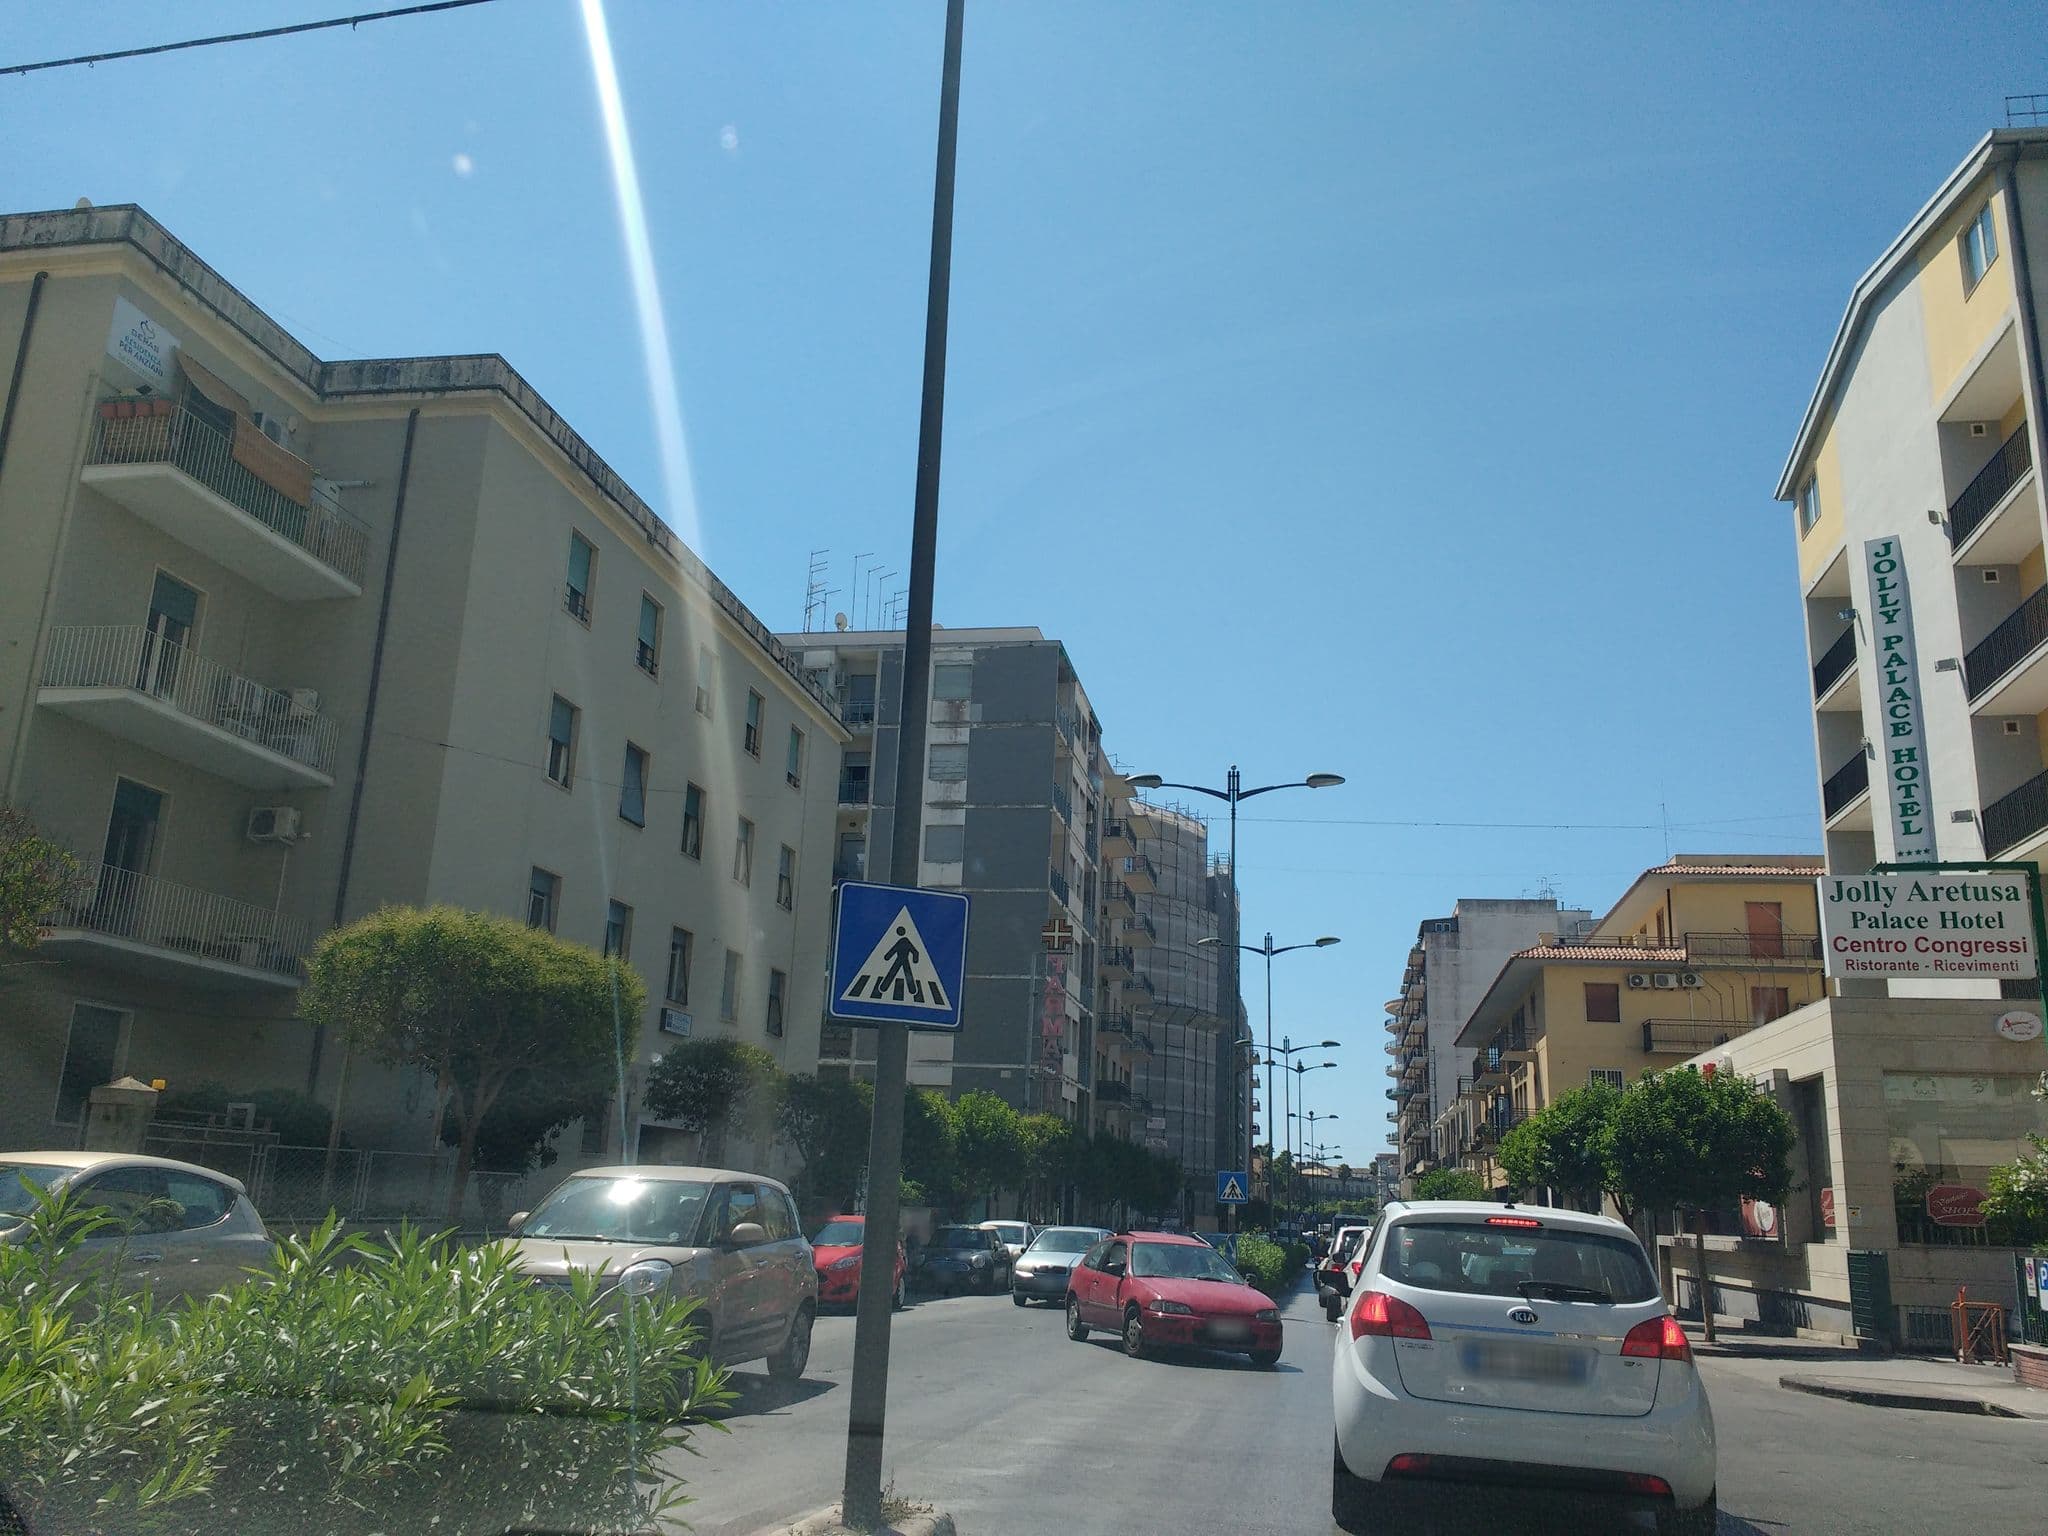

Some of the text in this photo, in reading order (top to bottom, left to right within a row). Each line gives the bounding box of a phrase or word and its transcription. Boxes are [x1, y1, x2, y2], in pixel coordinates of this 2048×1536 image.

[119, 340, 133, 355] PER
[1874, 541, 1923, 836] JOLLY PALACE HOTEL
[1829, 880, 2021, 908] Jolly Aretusa
[1851, 911, 2005, 929] Palace Hotel
[1833, 936, 2028, 957] Centro Congressi
[1845, 959, 1920, 972] Ristorante
[1934, 959, 2019, 972] Ricevimenti
[1514, 1311, 1536, 1322] KIA
